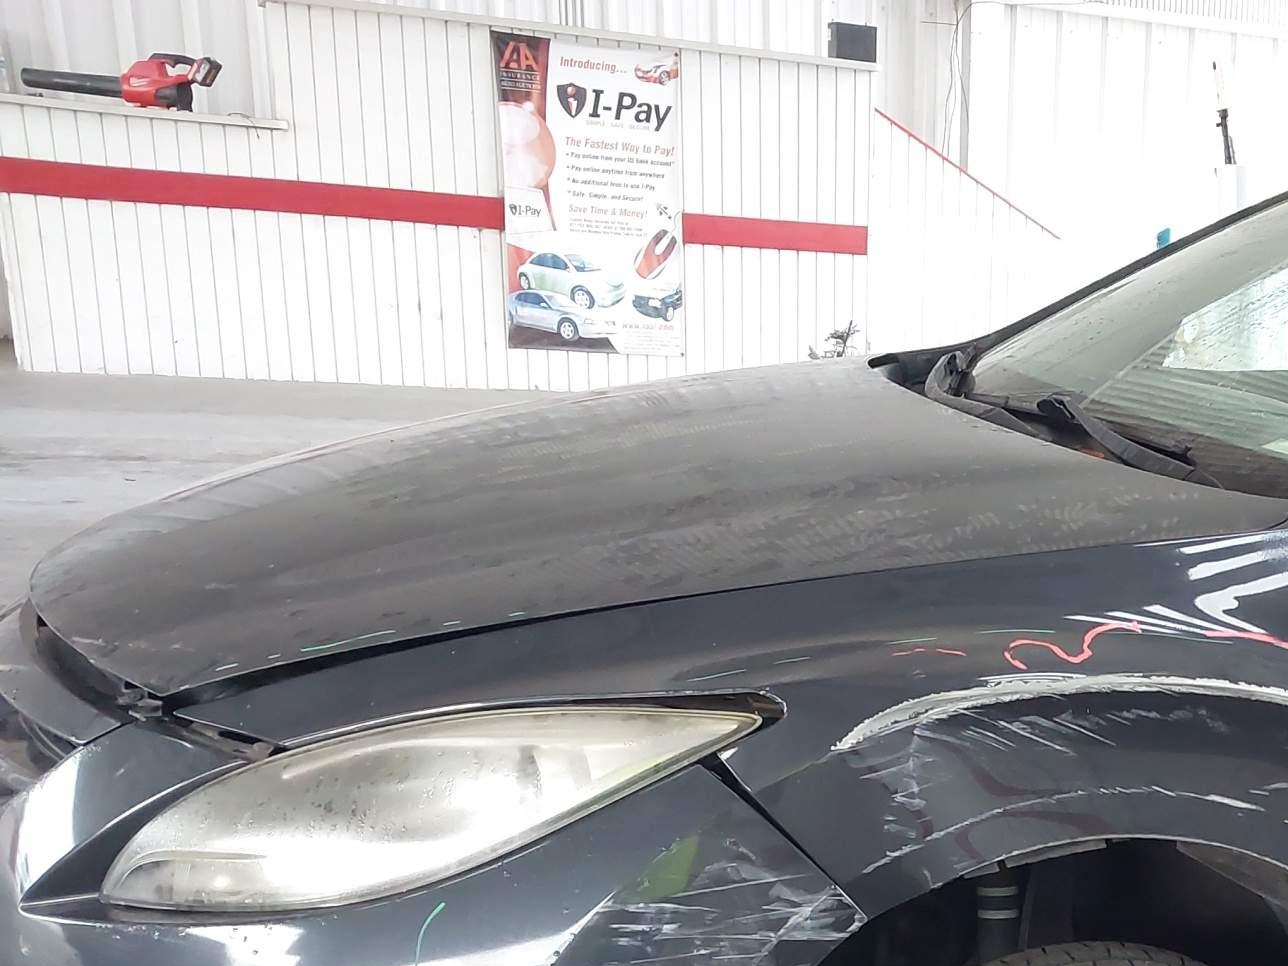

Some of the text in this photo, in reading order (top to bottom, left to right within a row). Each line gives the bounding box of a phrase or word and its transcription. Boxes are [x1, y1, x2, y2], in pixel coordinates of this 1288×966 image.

[560, 56, 628, 75] Introducing...
[588, 88, 673, 132] I-Pay
[565, 136, 675, 157] The Fastest Way to Pay!
[518, 204, 542, 218] I-Pay
[569, 203, 648, 219] Save Time & Money!
